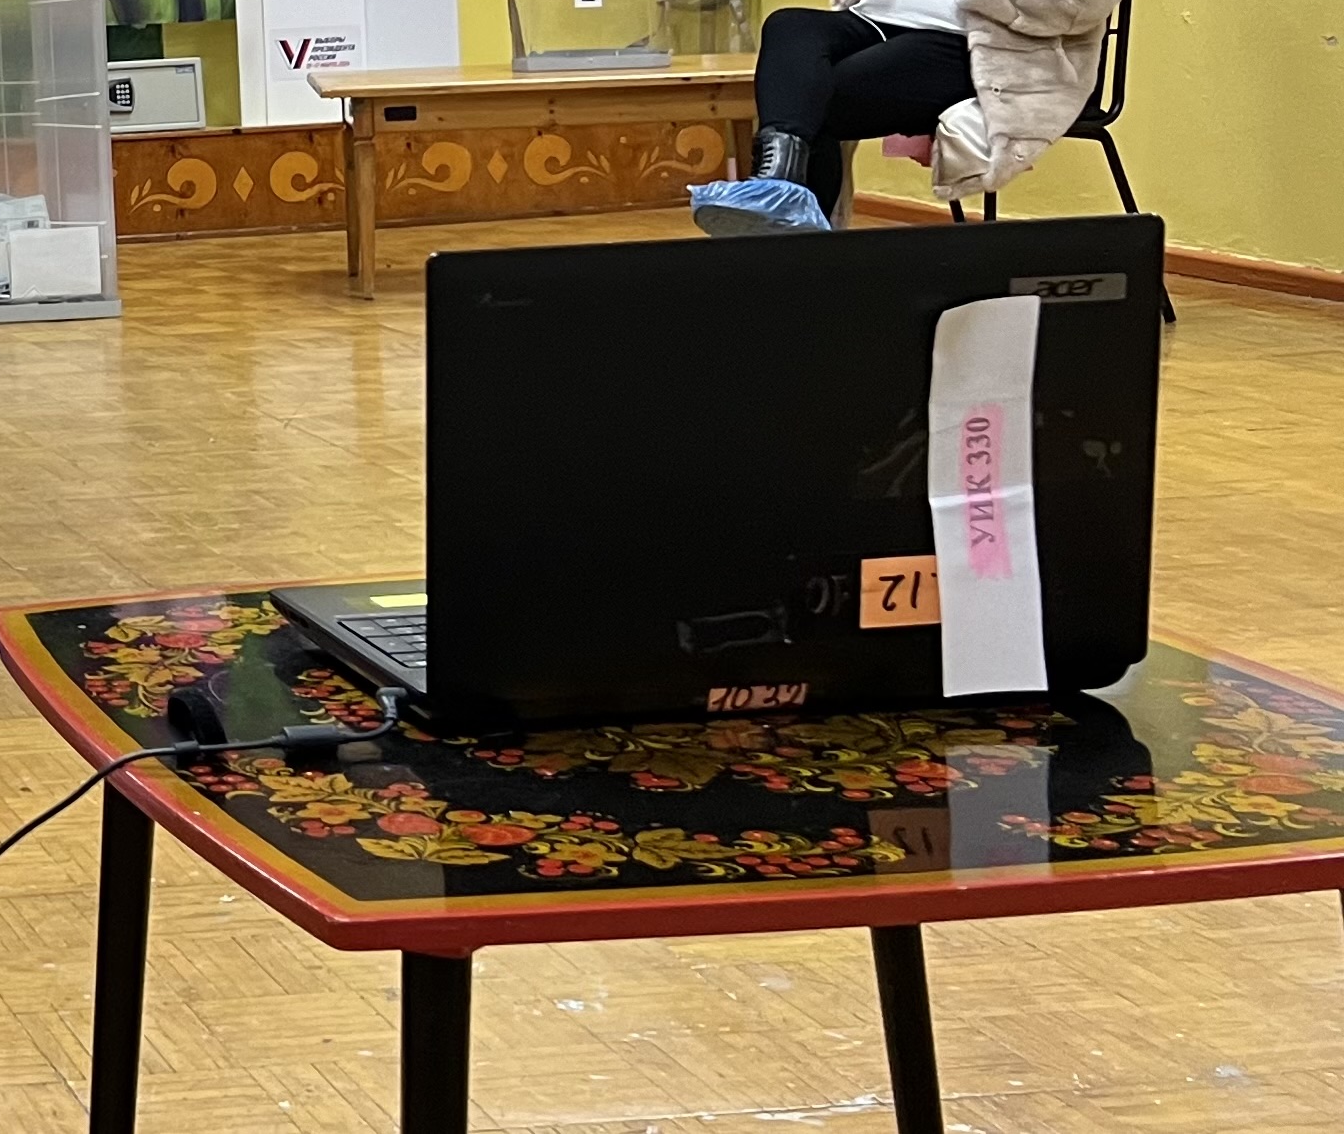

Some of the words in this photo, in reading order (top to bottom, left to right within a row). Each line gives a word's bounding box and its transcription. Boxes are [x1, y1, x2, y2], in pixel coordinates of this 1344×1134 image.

[1033, 278, 1103, 298] acer
[965, 416, 993, 466] 330
[965, 473, 996, 548] УИК
